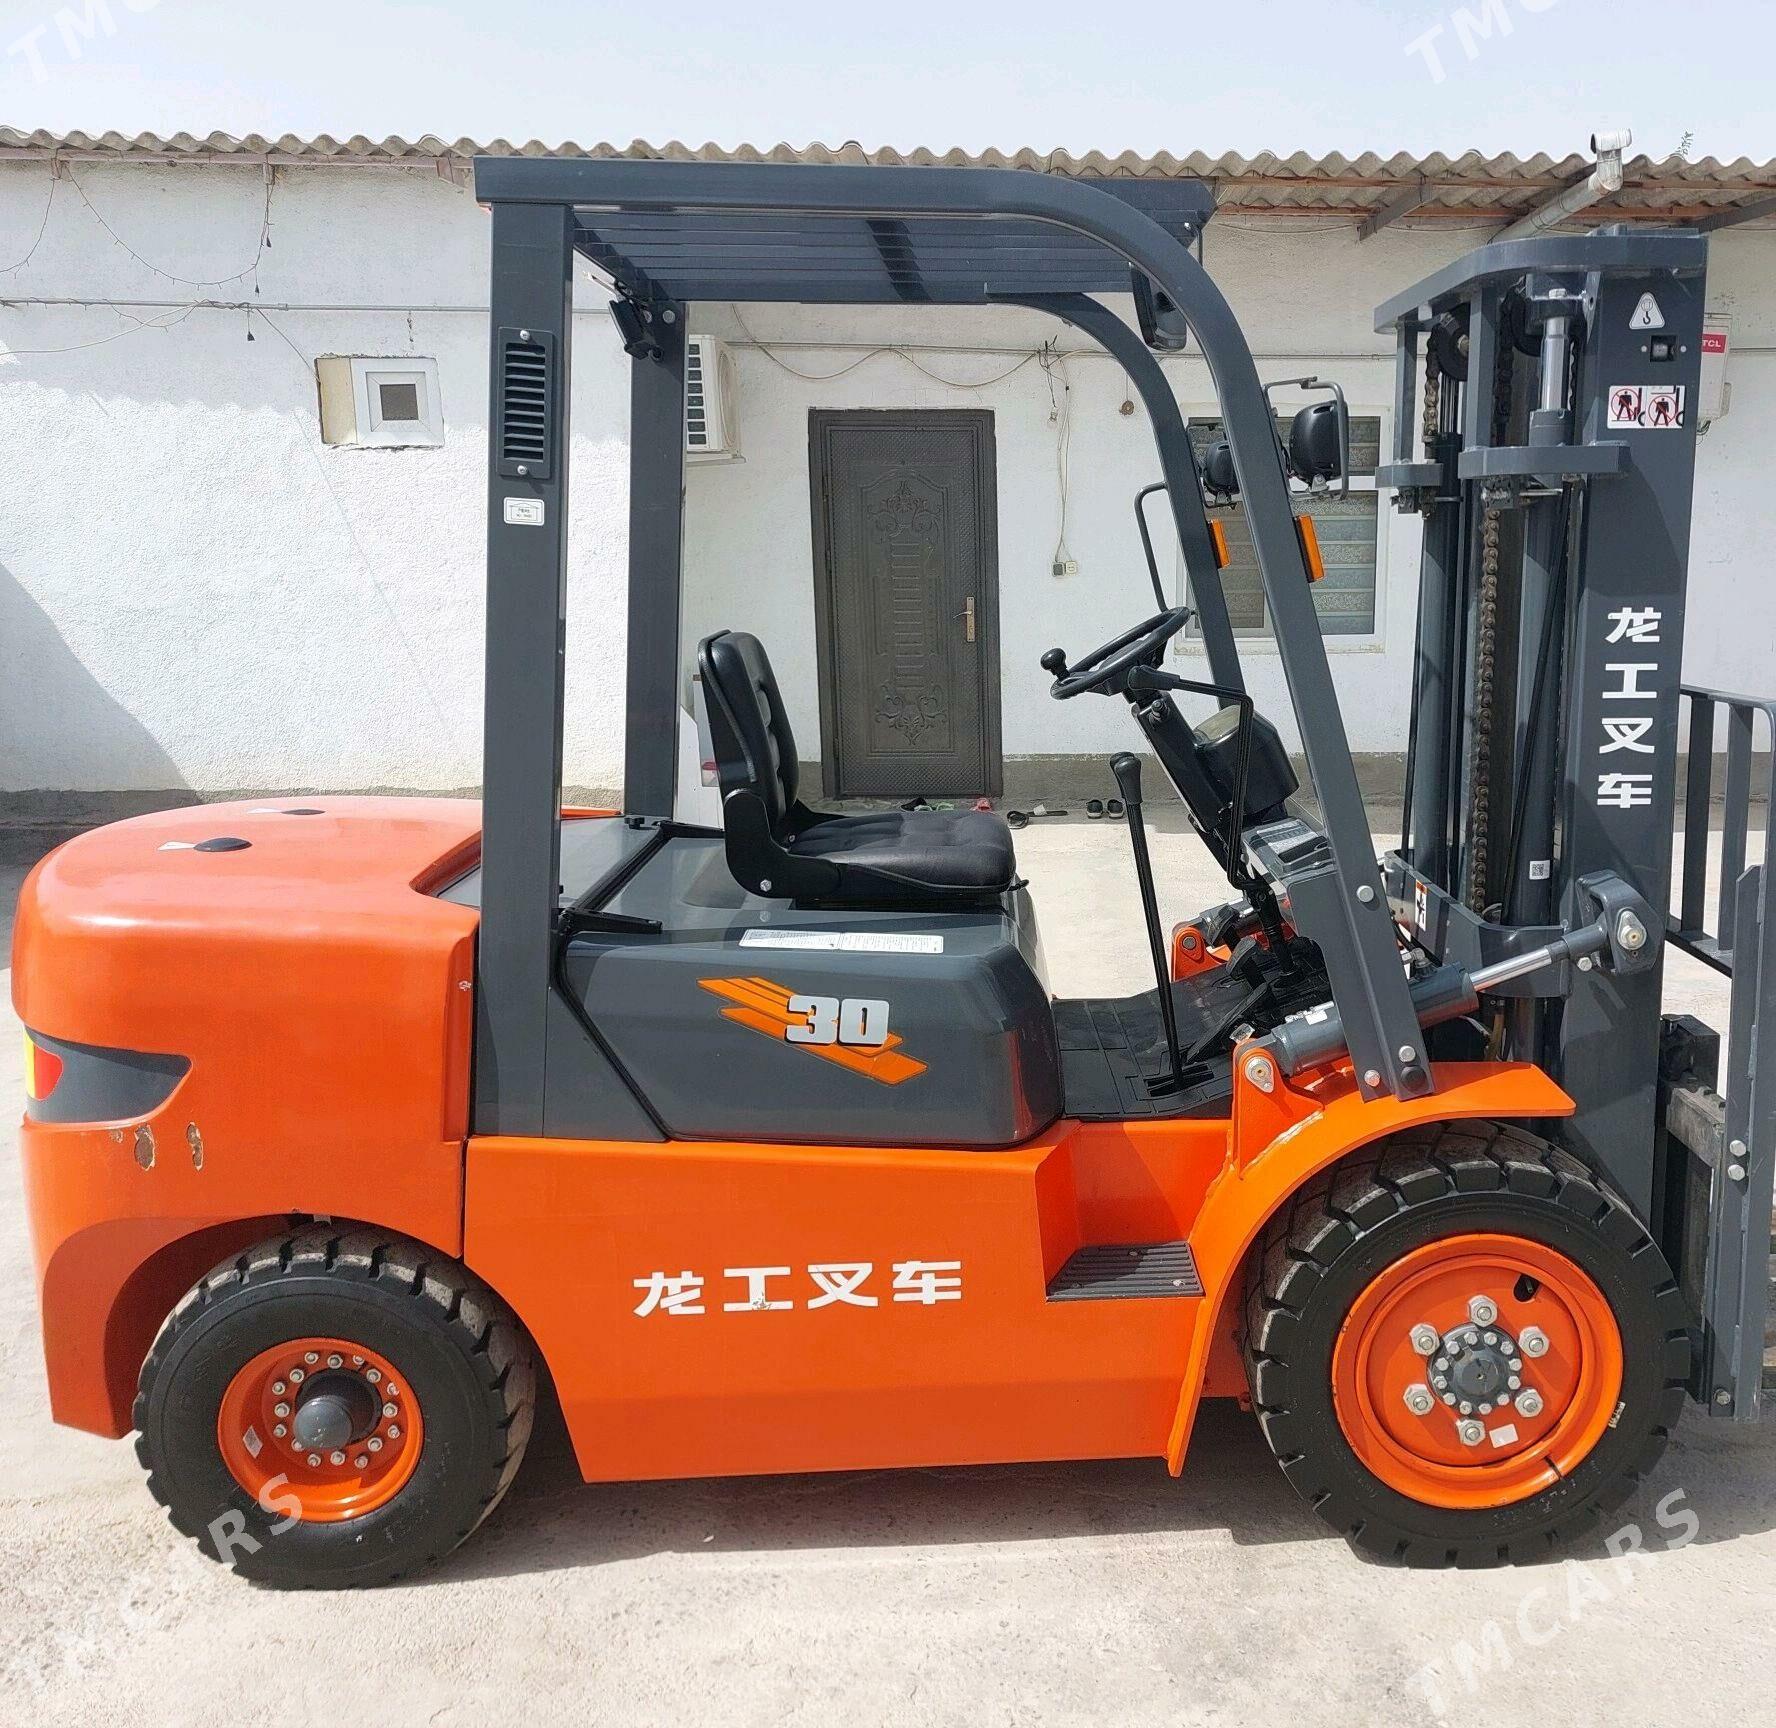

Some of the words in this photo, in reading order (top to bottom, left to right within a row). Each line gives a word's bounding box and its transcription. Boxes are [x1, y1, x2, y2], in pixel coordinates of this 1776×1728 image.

[1702, 339, 1721, 348] TCL
[1597, 607, 1662, 809] 龙工叉车
[786, 994, 890, 1044] 30
[633, 1260, 962, 1317] 龙工叉车
